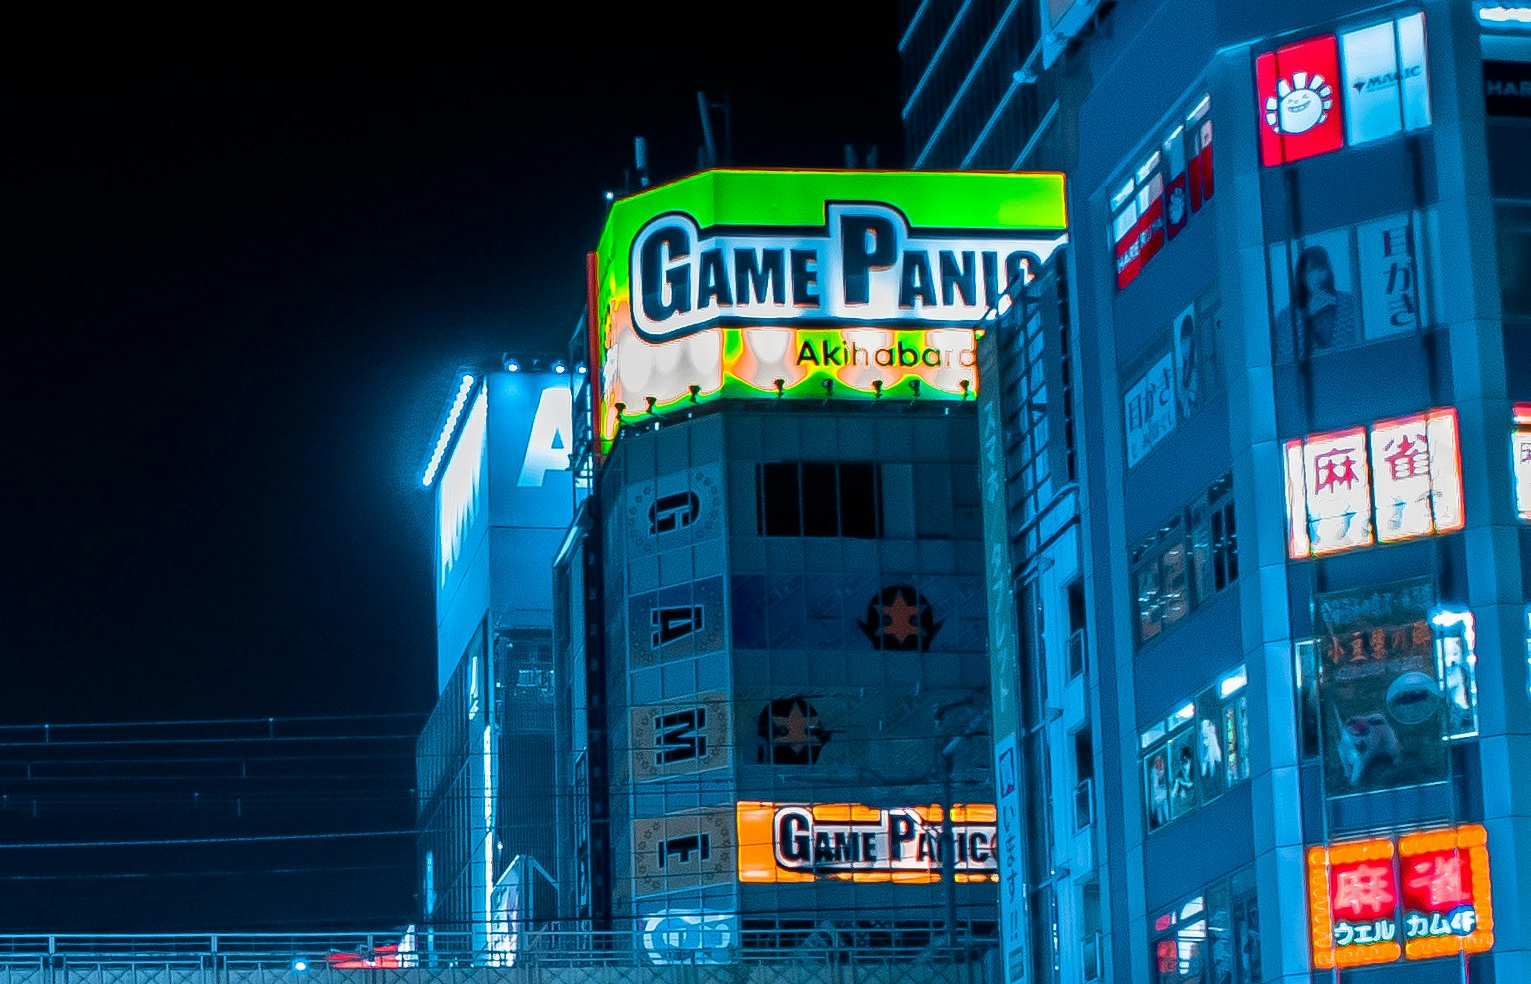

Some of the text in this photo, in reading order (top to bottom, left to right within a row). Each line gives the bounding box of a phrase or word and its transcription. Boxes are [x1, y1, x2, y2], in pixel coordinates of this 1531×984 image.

[639, 223, 820, 323] GAME
[1315, 433, 1430, 497] 麻雀
[778, 812, 991, 863] GAME PAIC
[1334, 855, 1471, 914] 麻雀
